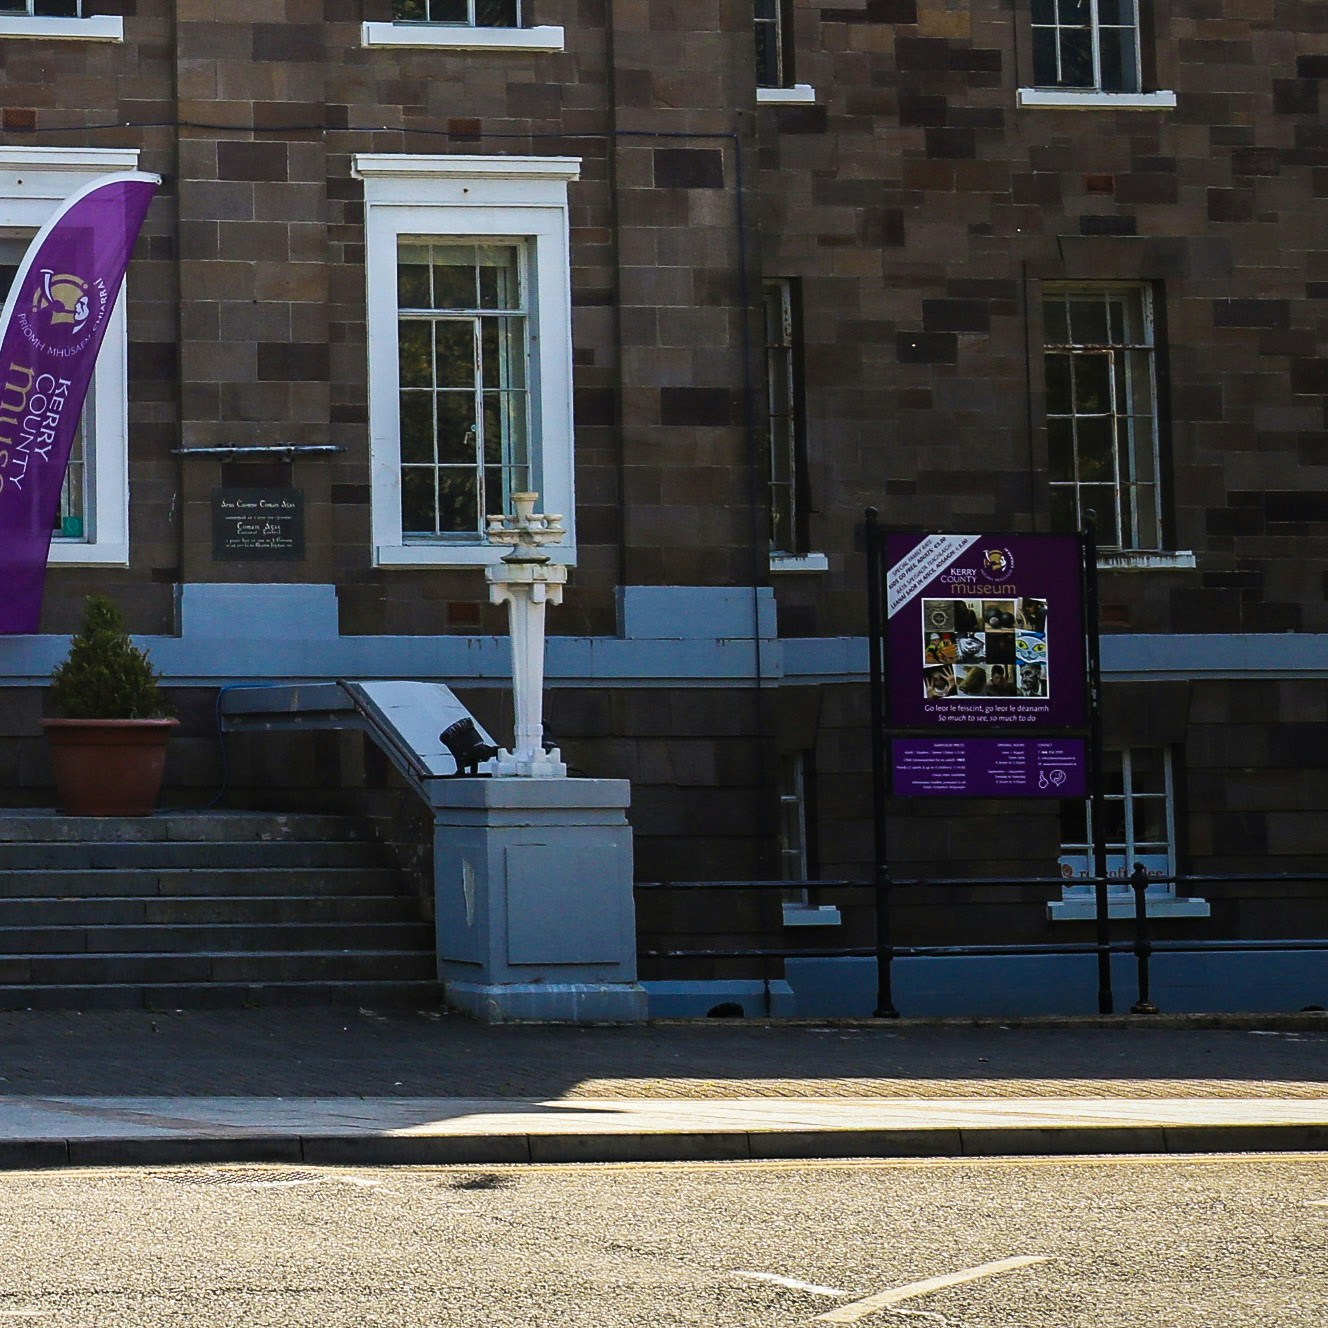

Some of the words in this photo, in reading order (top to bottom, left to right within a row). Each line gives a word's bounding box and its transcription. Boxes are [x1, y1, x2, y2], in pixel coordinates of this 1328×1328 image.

[34, 378, 72, 462] KERRY
[9, 373, 56, 490] COUNTY
[950, 568, 977, 576] KERRY
[940, 575, 977, 583] COUNTY
[951, 584, 1016, 595] museum
[924, 704, 935, 712] Go
[935, 704, 949, 712] leor
[950, 704, 957, 712] le
[985, 706, 994, 714] go
[995, 704, 1008, 712] leor
[1009, 704, 1016, 712] le
[1017, 704, 1049, 712] déanamh
[938, 714, 946, 722] So
[947, 714, 966, 722] much
[967, 714, 975, 722] to
[998, 714, 1017, 722] much
[1018, 714, 1026, 722] to
[1027, 714, 1036, 722] do
